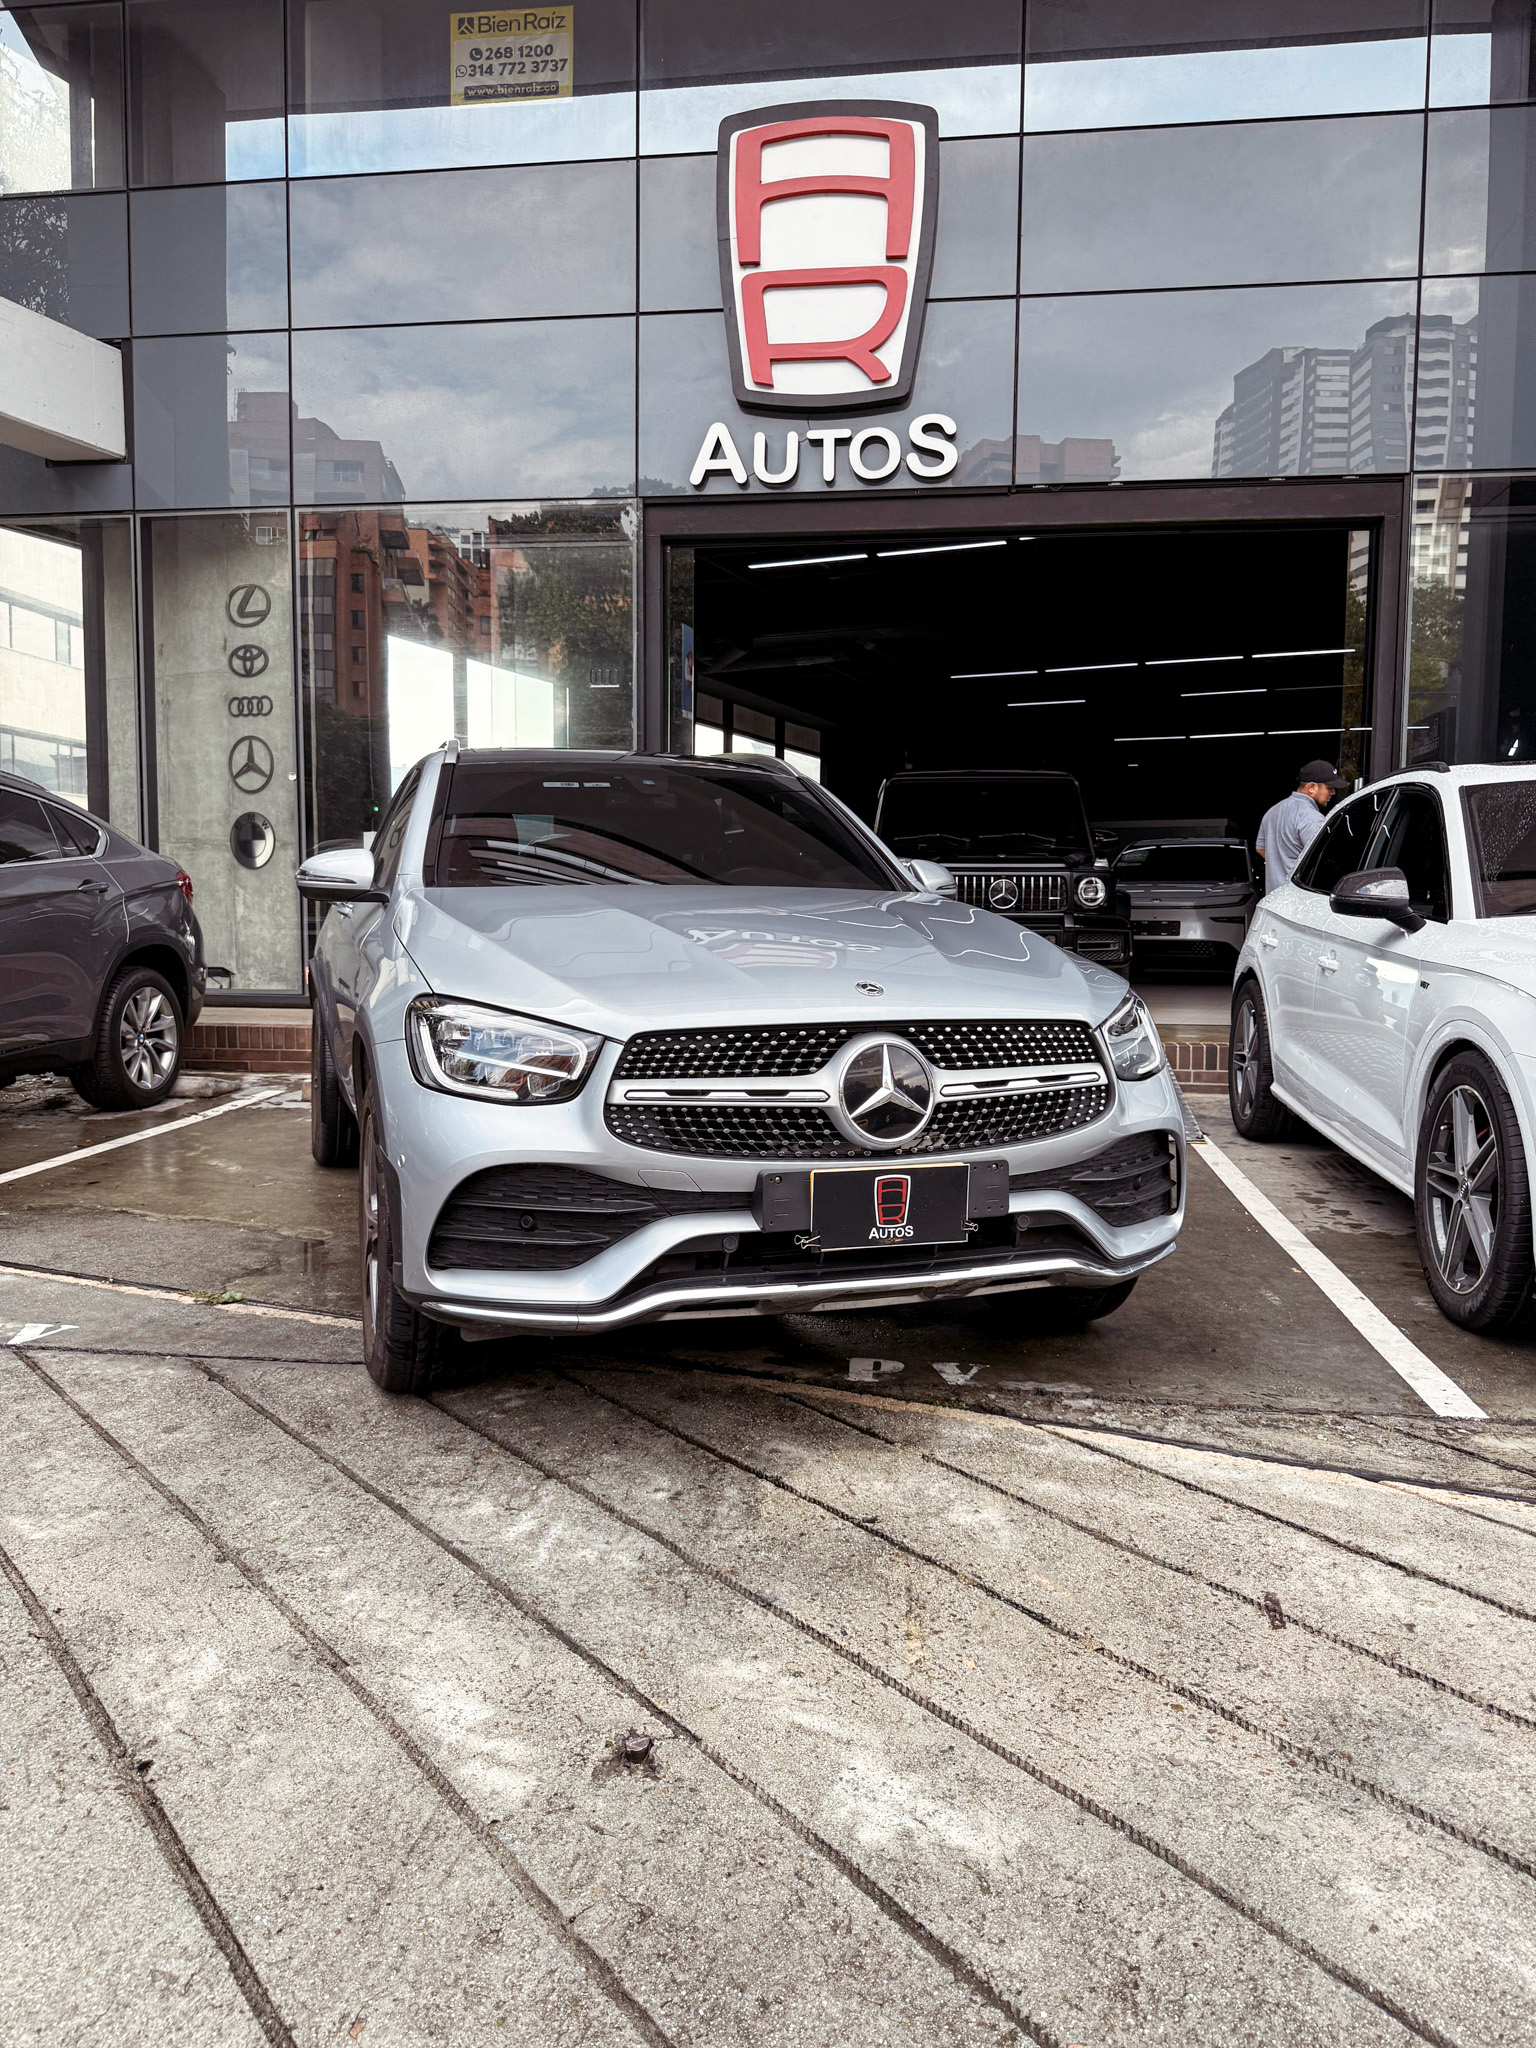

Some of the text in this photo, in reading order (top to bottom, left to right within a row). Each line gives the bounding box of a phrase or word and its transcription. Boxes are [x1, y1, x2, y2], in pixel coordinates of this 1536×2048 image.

[477, 11, 566, 34] Bien Raíz
[484, 44, 554, 61] 268 1200
[468, 58, 568, 78] 314 772 3737
[689, 413, 959, 486] AUTOS
[868, 1225, 914, 1240] AUTOS
